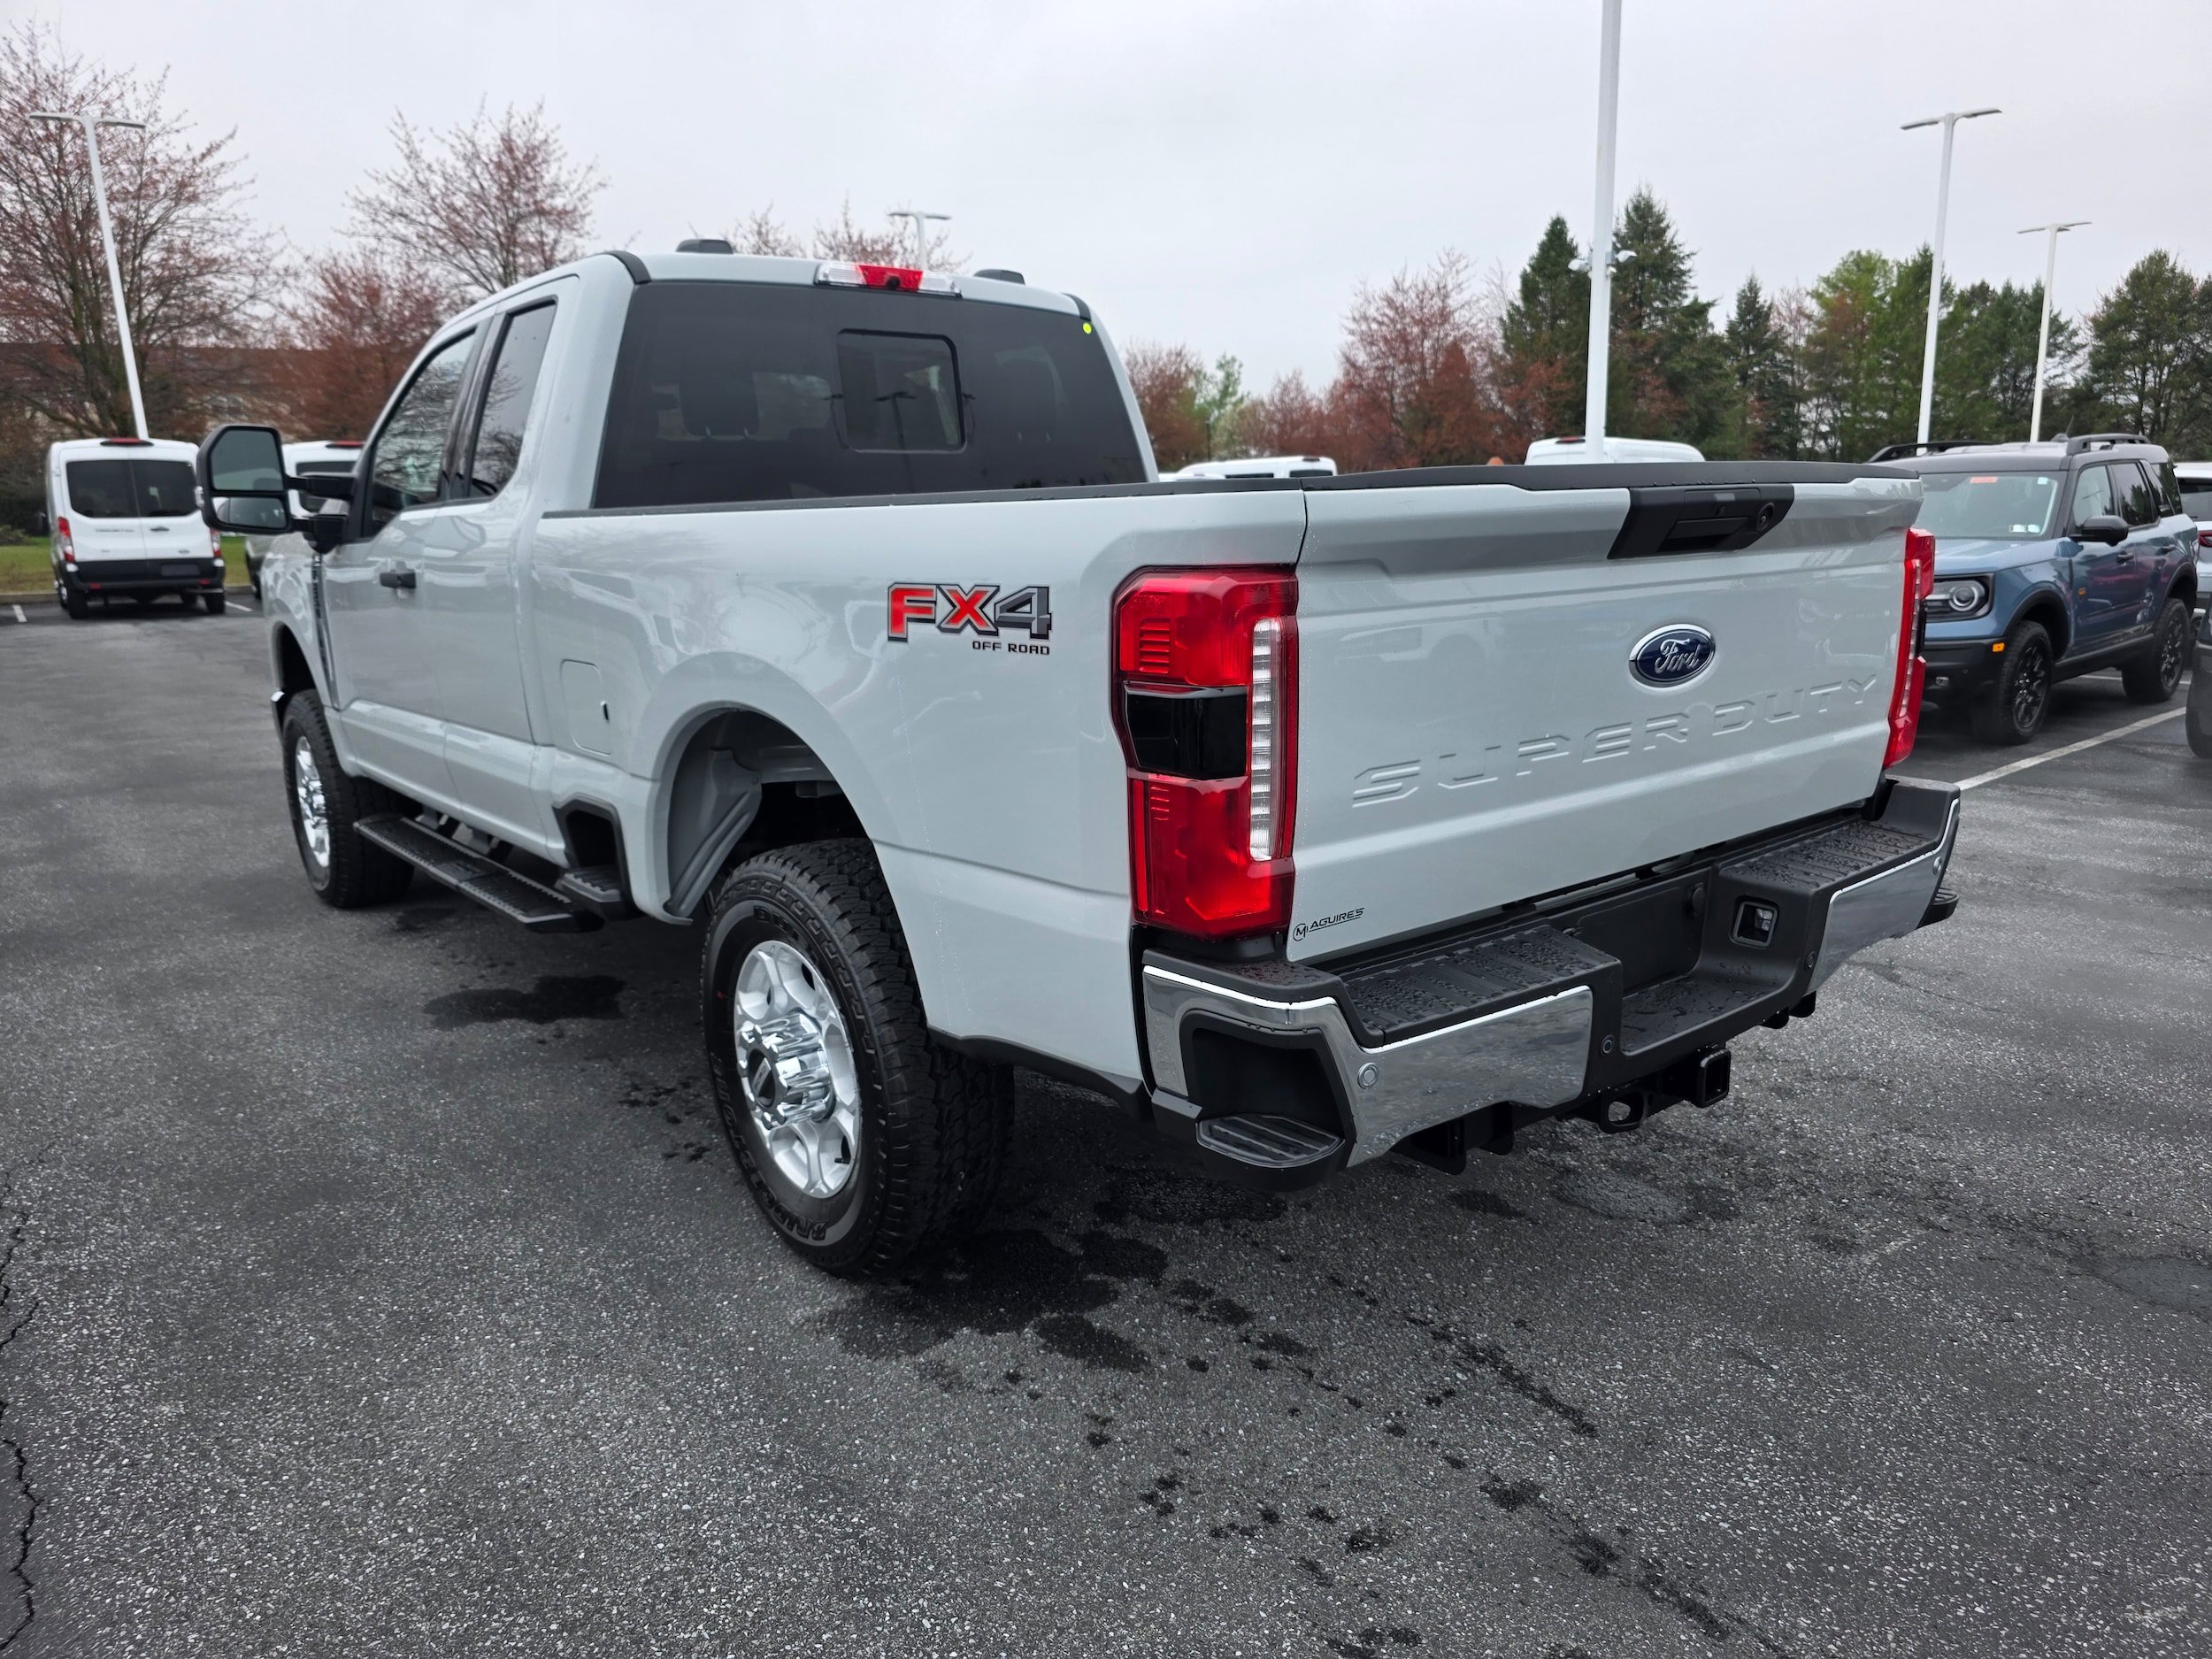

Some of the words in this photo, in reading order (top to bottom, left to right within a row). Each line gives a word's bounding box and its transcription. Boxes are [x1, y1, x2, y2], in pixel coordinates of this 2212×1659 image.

[887, 581, 1052, 643] FX4
[972, 641, 1002, 651] OFF
[1008, 643, 1050, 656] ROAD
[1654, 638, 1700, 674] Ford
[1352, 710, 1690, 809] SUPER
[1711, 673, 1878, 737] DUTY
